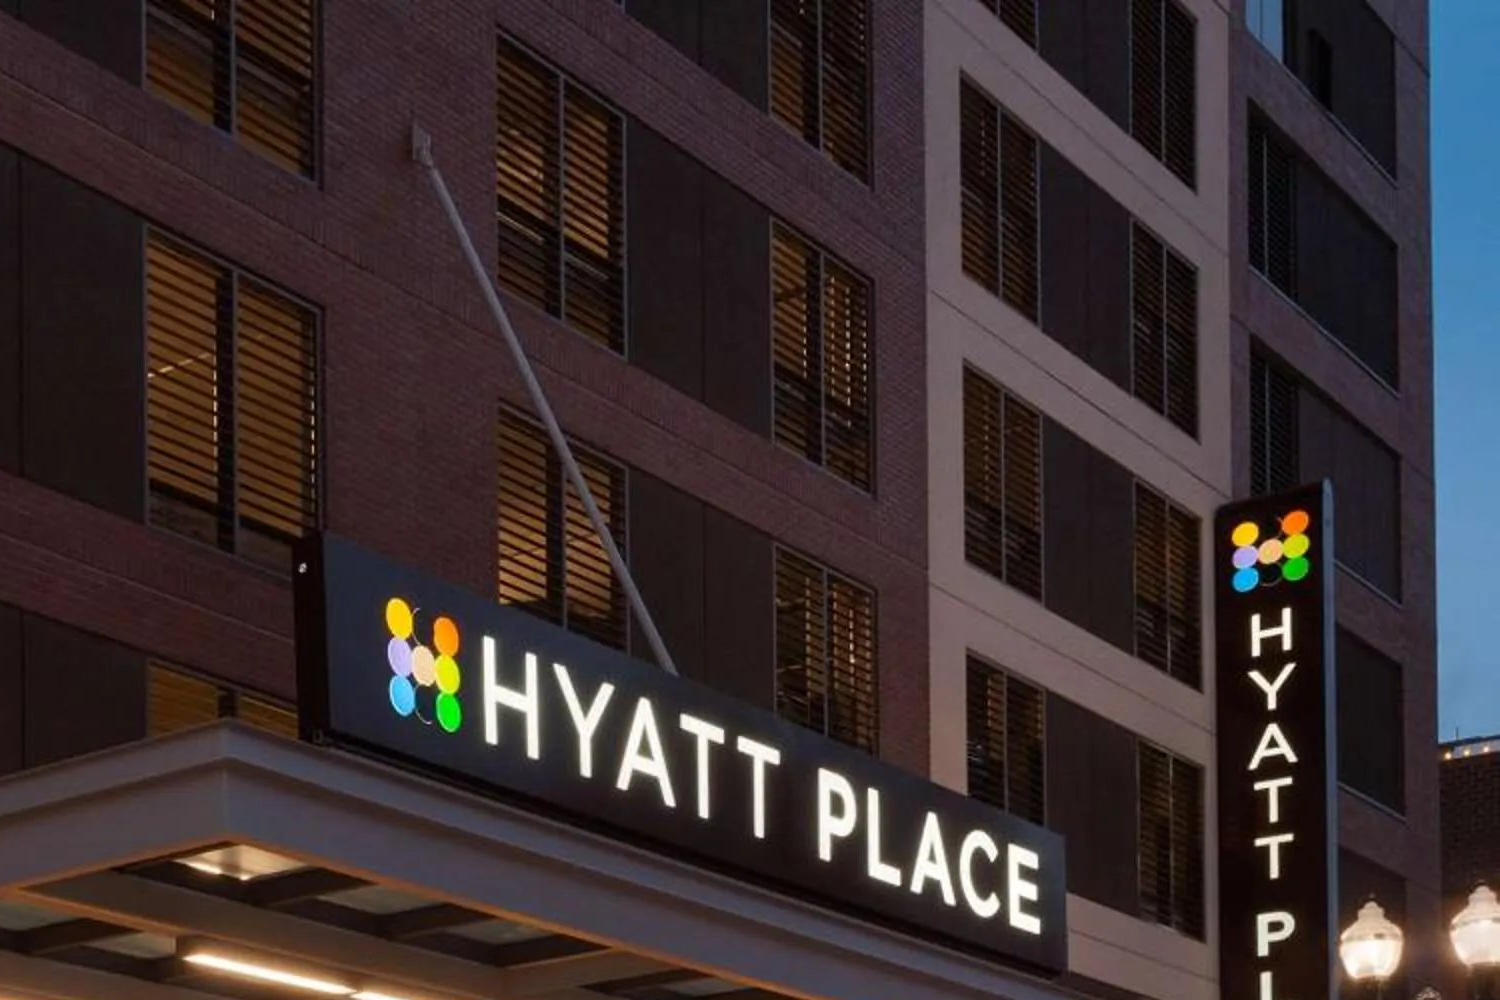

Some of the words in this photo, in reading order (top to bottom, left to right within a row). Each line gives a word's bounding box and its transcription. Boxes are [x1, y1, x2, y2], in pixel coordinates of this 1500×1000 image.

[481, 634, 781, 840] HYATT
[817, 766, 1042, 936] PLACE
[1247, 606, 1298, 880] HYATT
